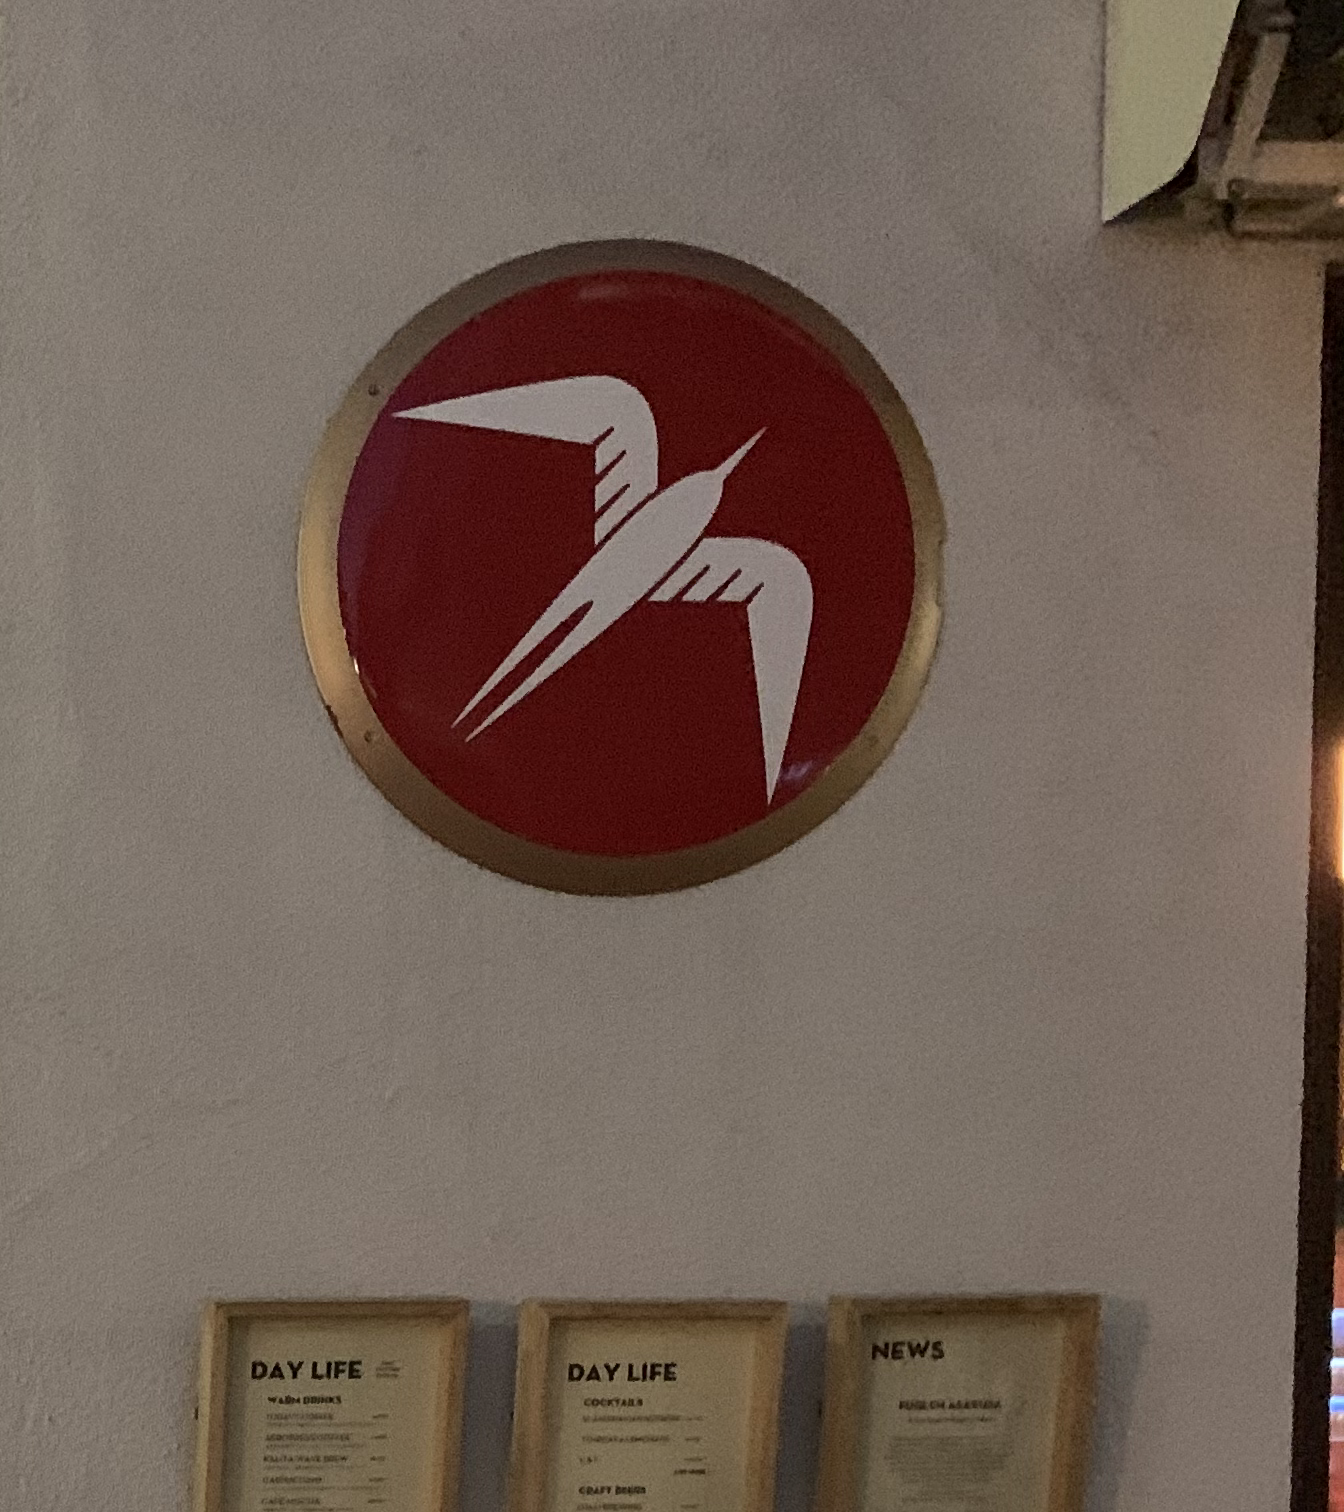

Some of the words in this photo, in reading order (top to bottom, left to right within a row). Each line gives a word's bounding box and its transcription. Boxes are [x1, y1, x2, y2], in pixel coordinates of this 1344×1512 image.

[871, 1340, 945, 1360] NEWS
[251, 1360, 304, 1380] DAY
[311, 1360, 362, 1380] LIFE
[567, 1362, 620, 1382] DAY
[627, 1361, 678, 1382] LIFE
[303, 1395, 342, 1405] DRINKS
[583, 1398, 643, 1407] COCKTAILS
[578, 1486, 612, 1495] CRAFT
